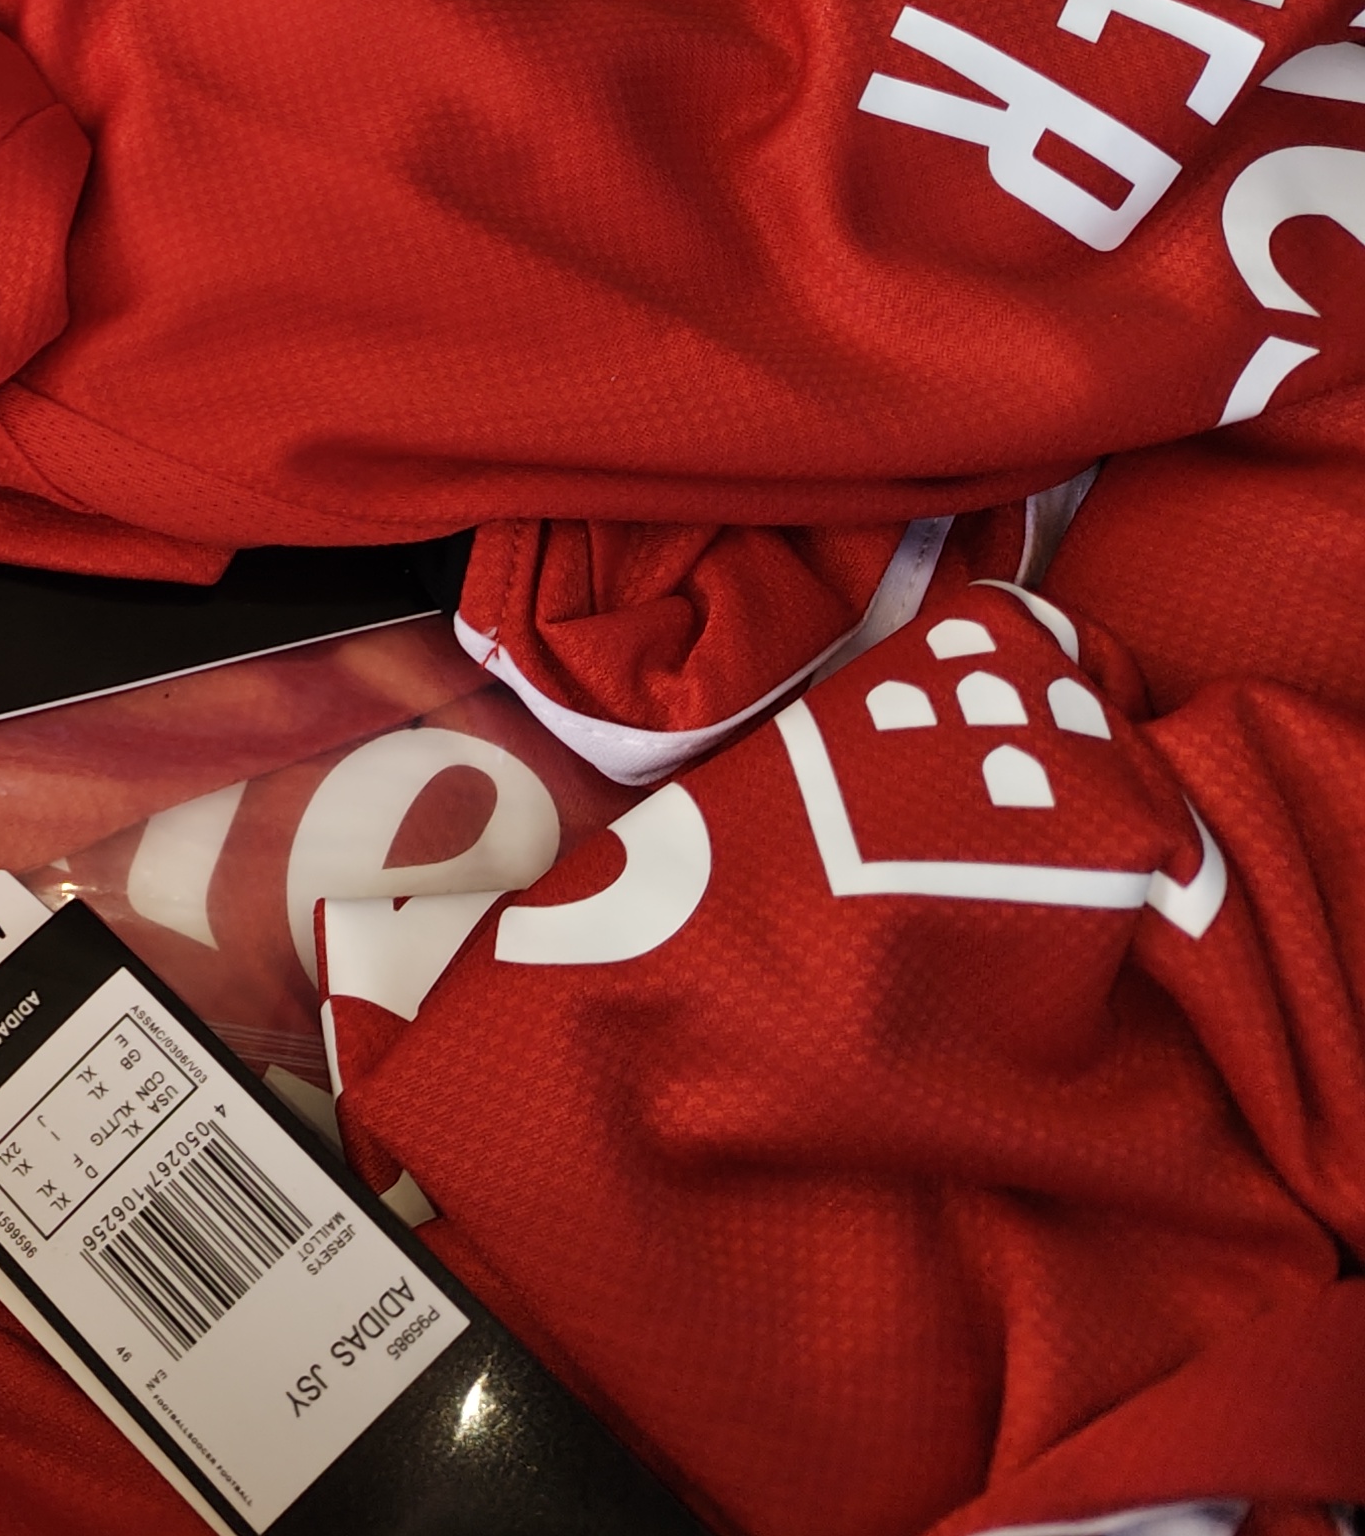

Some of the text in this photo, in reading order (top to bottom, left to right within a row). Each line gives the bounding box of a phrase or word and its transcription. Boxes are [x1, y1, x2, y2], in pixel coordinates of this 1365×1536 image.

[112, 1032, 129, 1048] E
[116, 1045, 143, 1071] GB
[129, 1003, 207, 1084] ASSMC/0306/V03
[74, 1064, 98, 1086] XL
[86, 1080, 109, 1102] XL
[33, 1113, 50, 1128] J
[34, 1068, 166, 1200] CDN XL/TTG F XL
[9, 1157, 33, 1179] XL
[47, 1082, 179, 1214] USA XL D XL
[79, 1100, 230, 1252] 4 050267 106256
[294, 1211, 346, 1262] MAILLOT
[304, 1222, 359, 1276] JERSEYS
[276, 1272, 420, 1417] ADIDAS JSY
[381, 1302, 442, 1362] P95985
[141, 1366, 168, 1392] EAN
[215, 1464, 254, 1507] FOOTBALL
